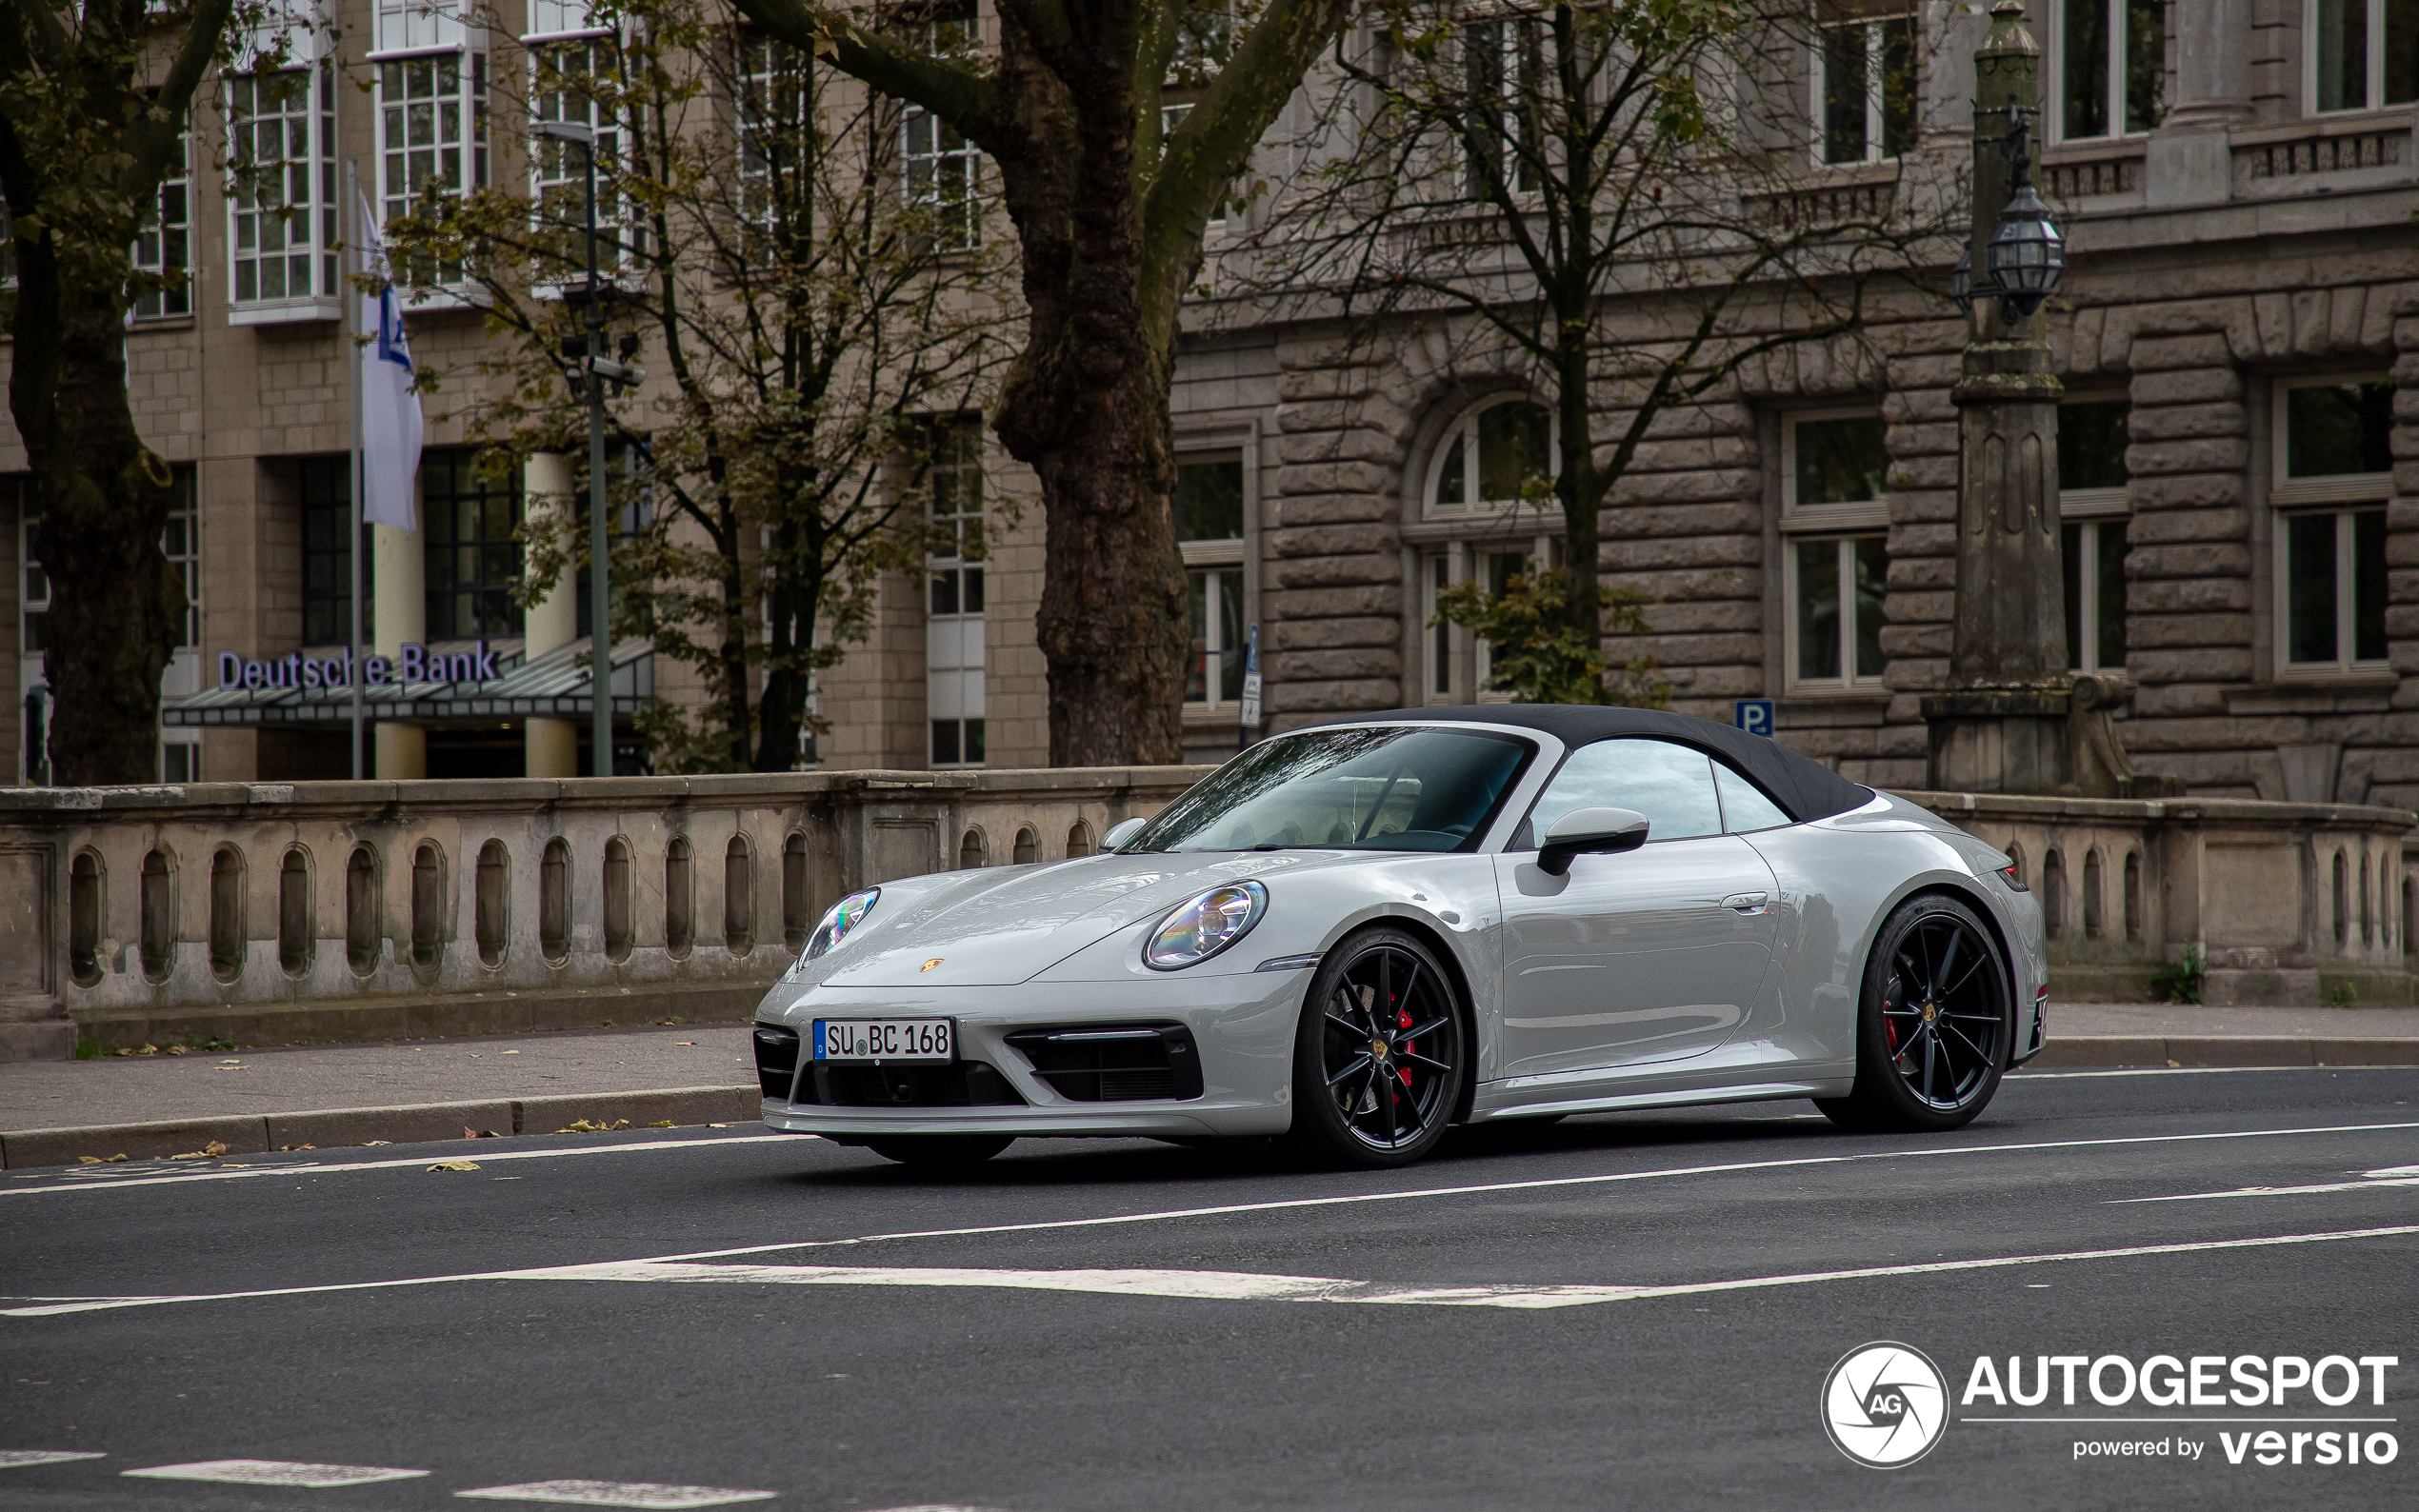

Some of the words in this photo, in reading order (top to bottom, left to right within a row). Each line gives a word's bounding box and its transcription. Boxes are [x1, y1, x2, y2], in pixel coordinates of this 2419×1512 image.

[219, 647, 387, 691] Deutsche
[401, 639, 499, 683] Bank
[1744, 705, 1765, 731] P
[828, 1025, 853, 1055] SU
[869, 1025, 898, 1054] BC
[905, 1025, 949, 1054] 168
